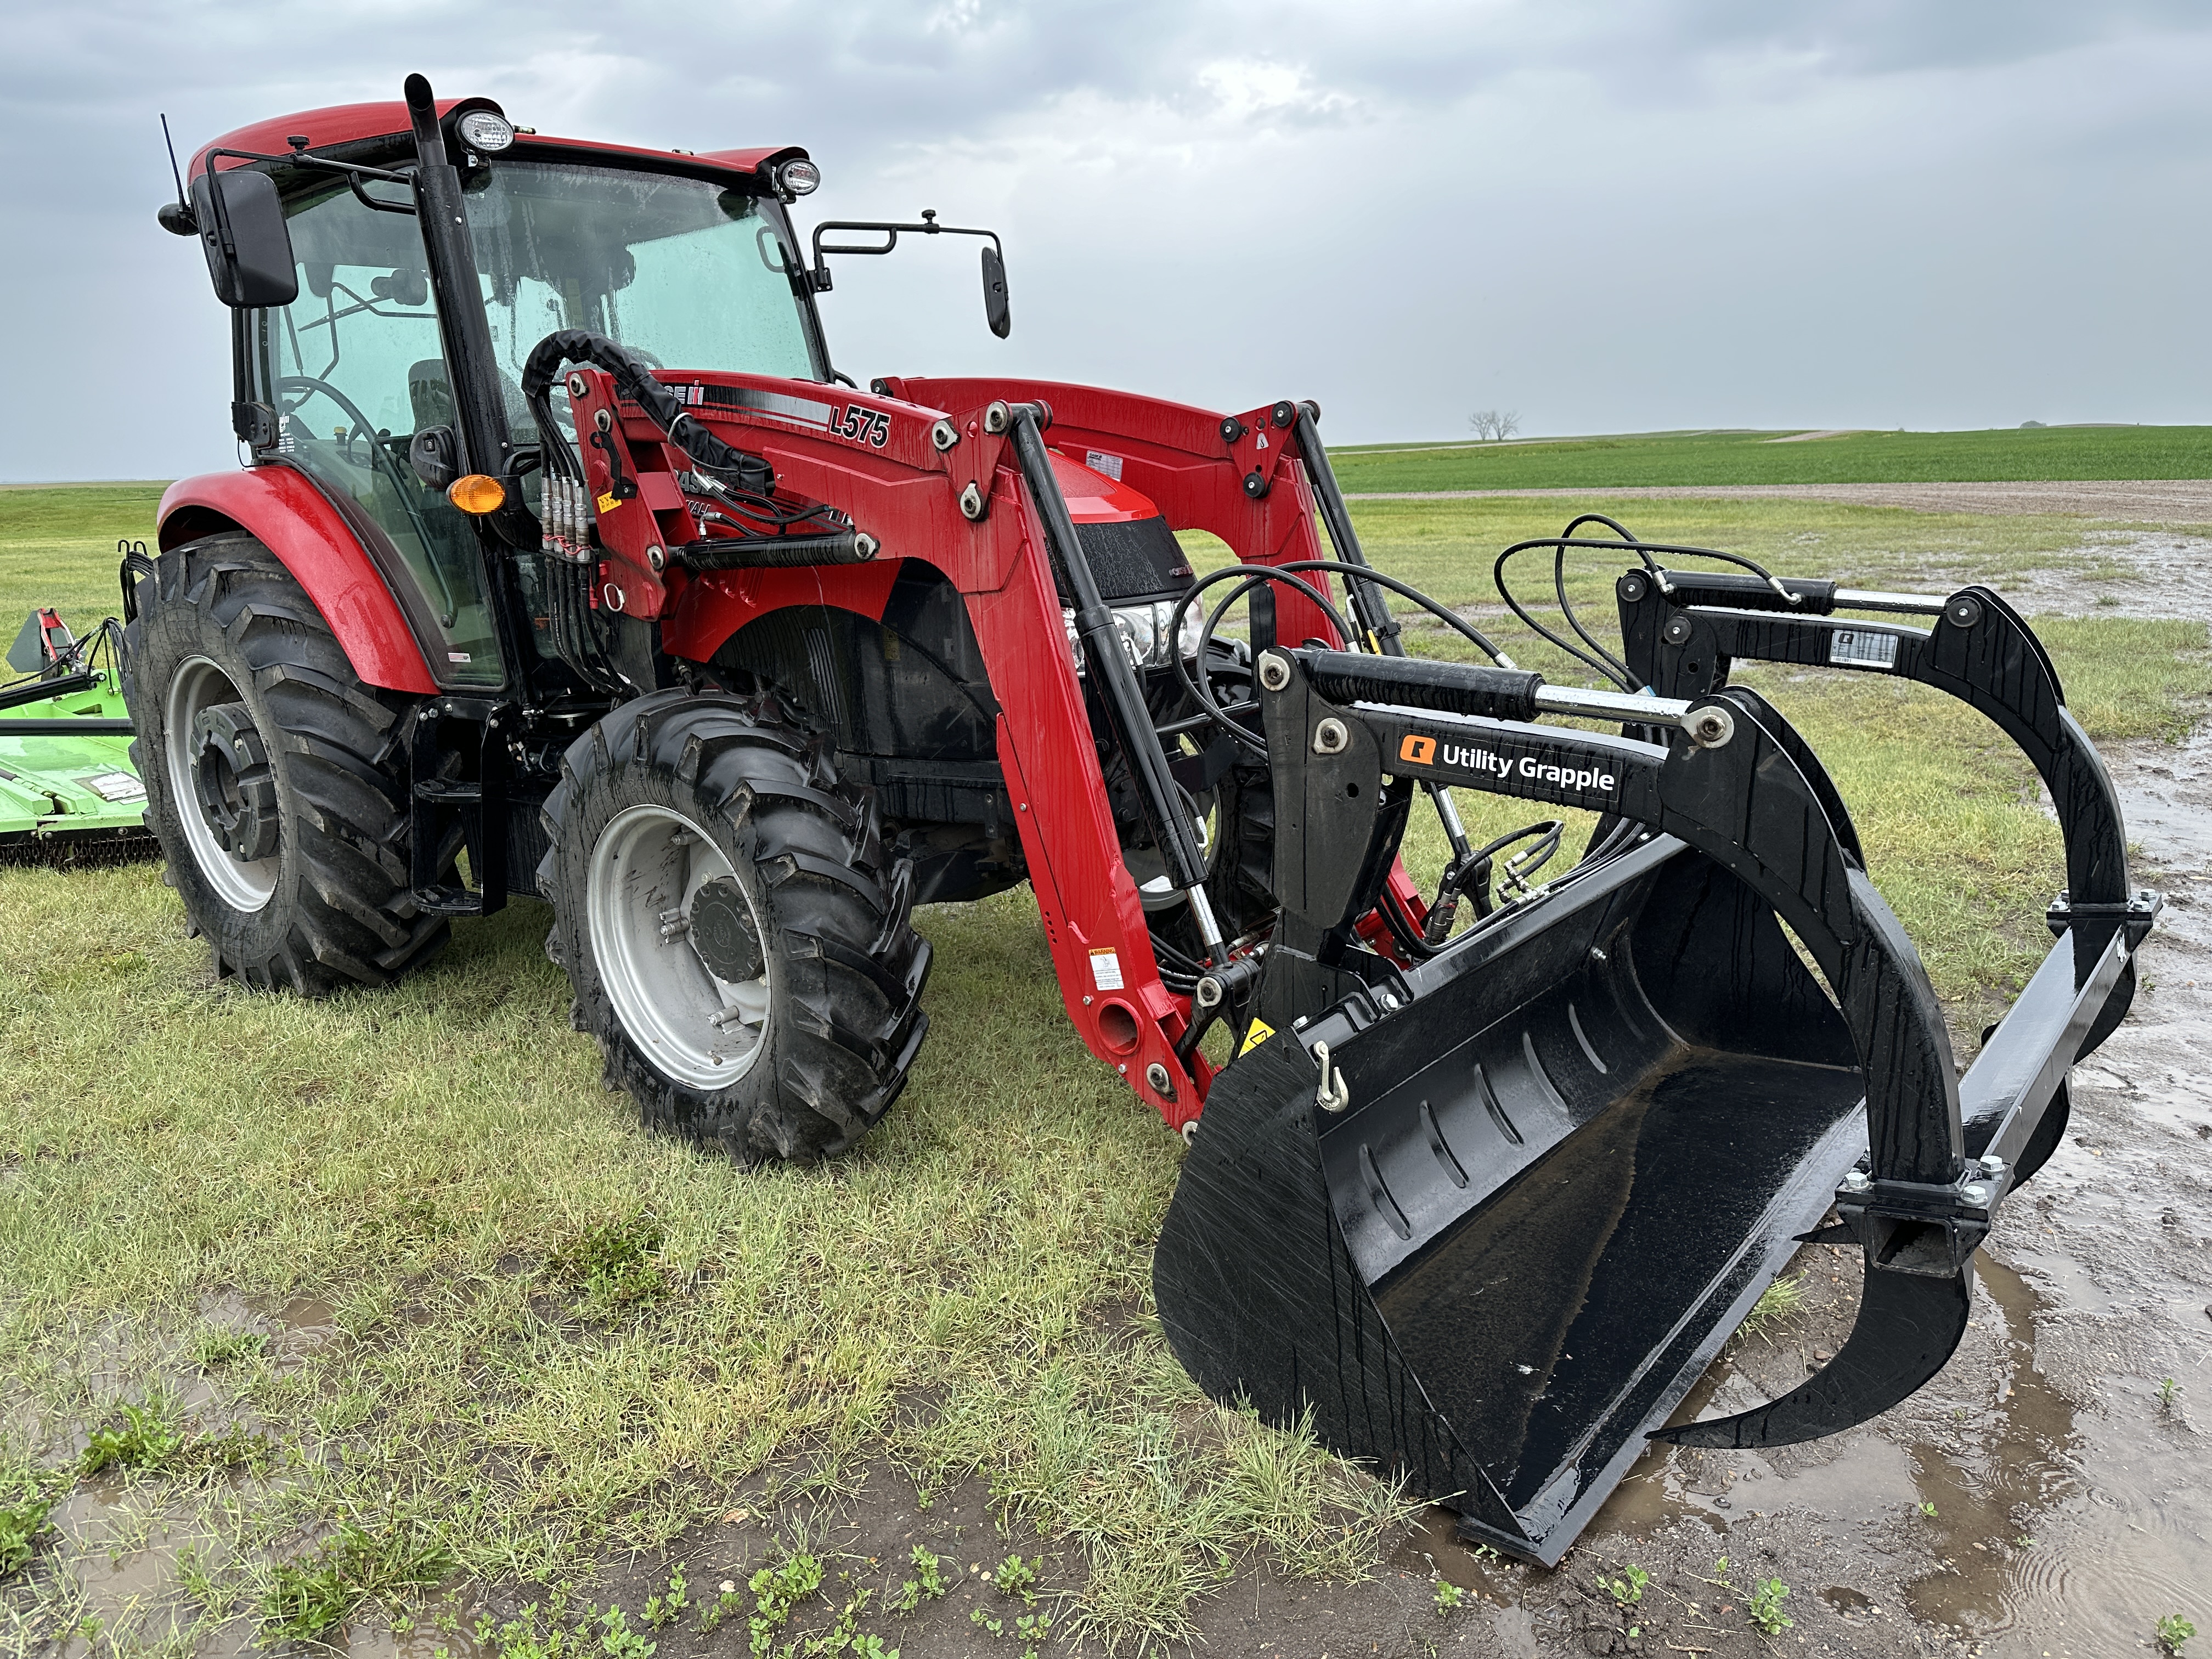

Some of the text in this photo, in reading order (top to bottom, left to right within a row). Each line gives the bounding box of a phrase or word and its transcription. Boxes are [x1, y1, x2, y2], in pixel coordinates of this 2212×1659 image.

[828, 403, 891, 449] L575
[1443, 744, 1615, 791] Utility Grapple
